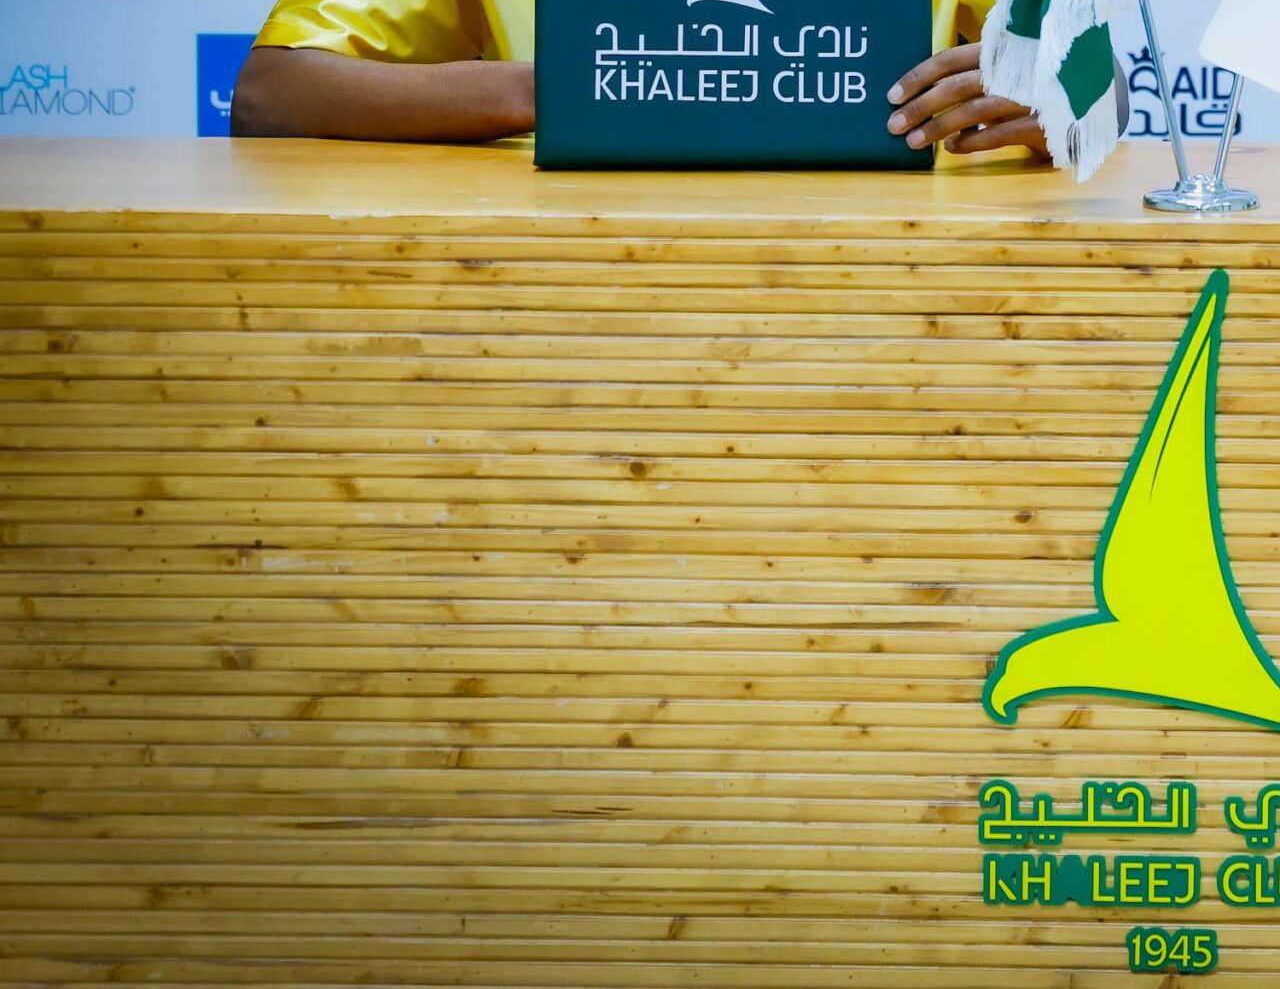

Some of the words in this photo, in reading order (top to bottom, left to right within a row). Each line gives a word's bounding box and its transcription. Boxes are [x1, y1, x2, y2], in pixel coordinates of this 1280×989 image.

[595, 22, 759, 66] الخليج
[773, 25, 868, 68] نادي
[594, 69, 759, 102] KHALEEJ
[773, 71, 867, 104] CLUB
[981, 783, 1192, 841] الخليج
[986, 859, 1197, 904] KHLEEJ
[1129, 933, 1214, 969] 1945
